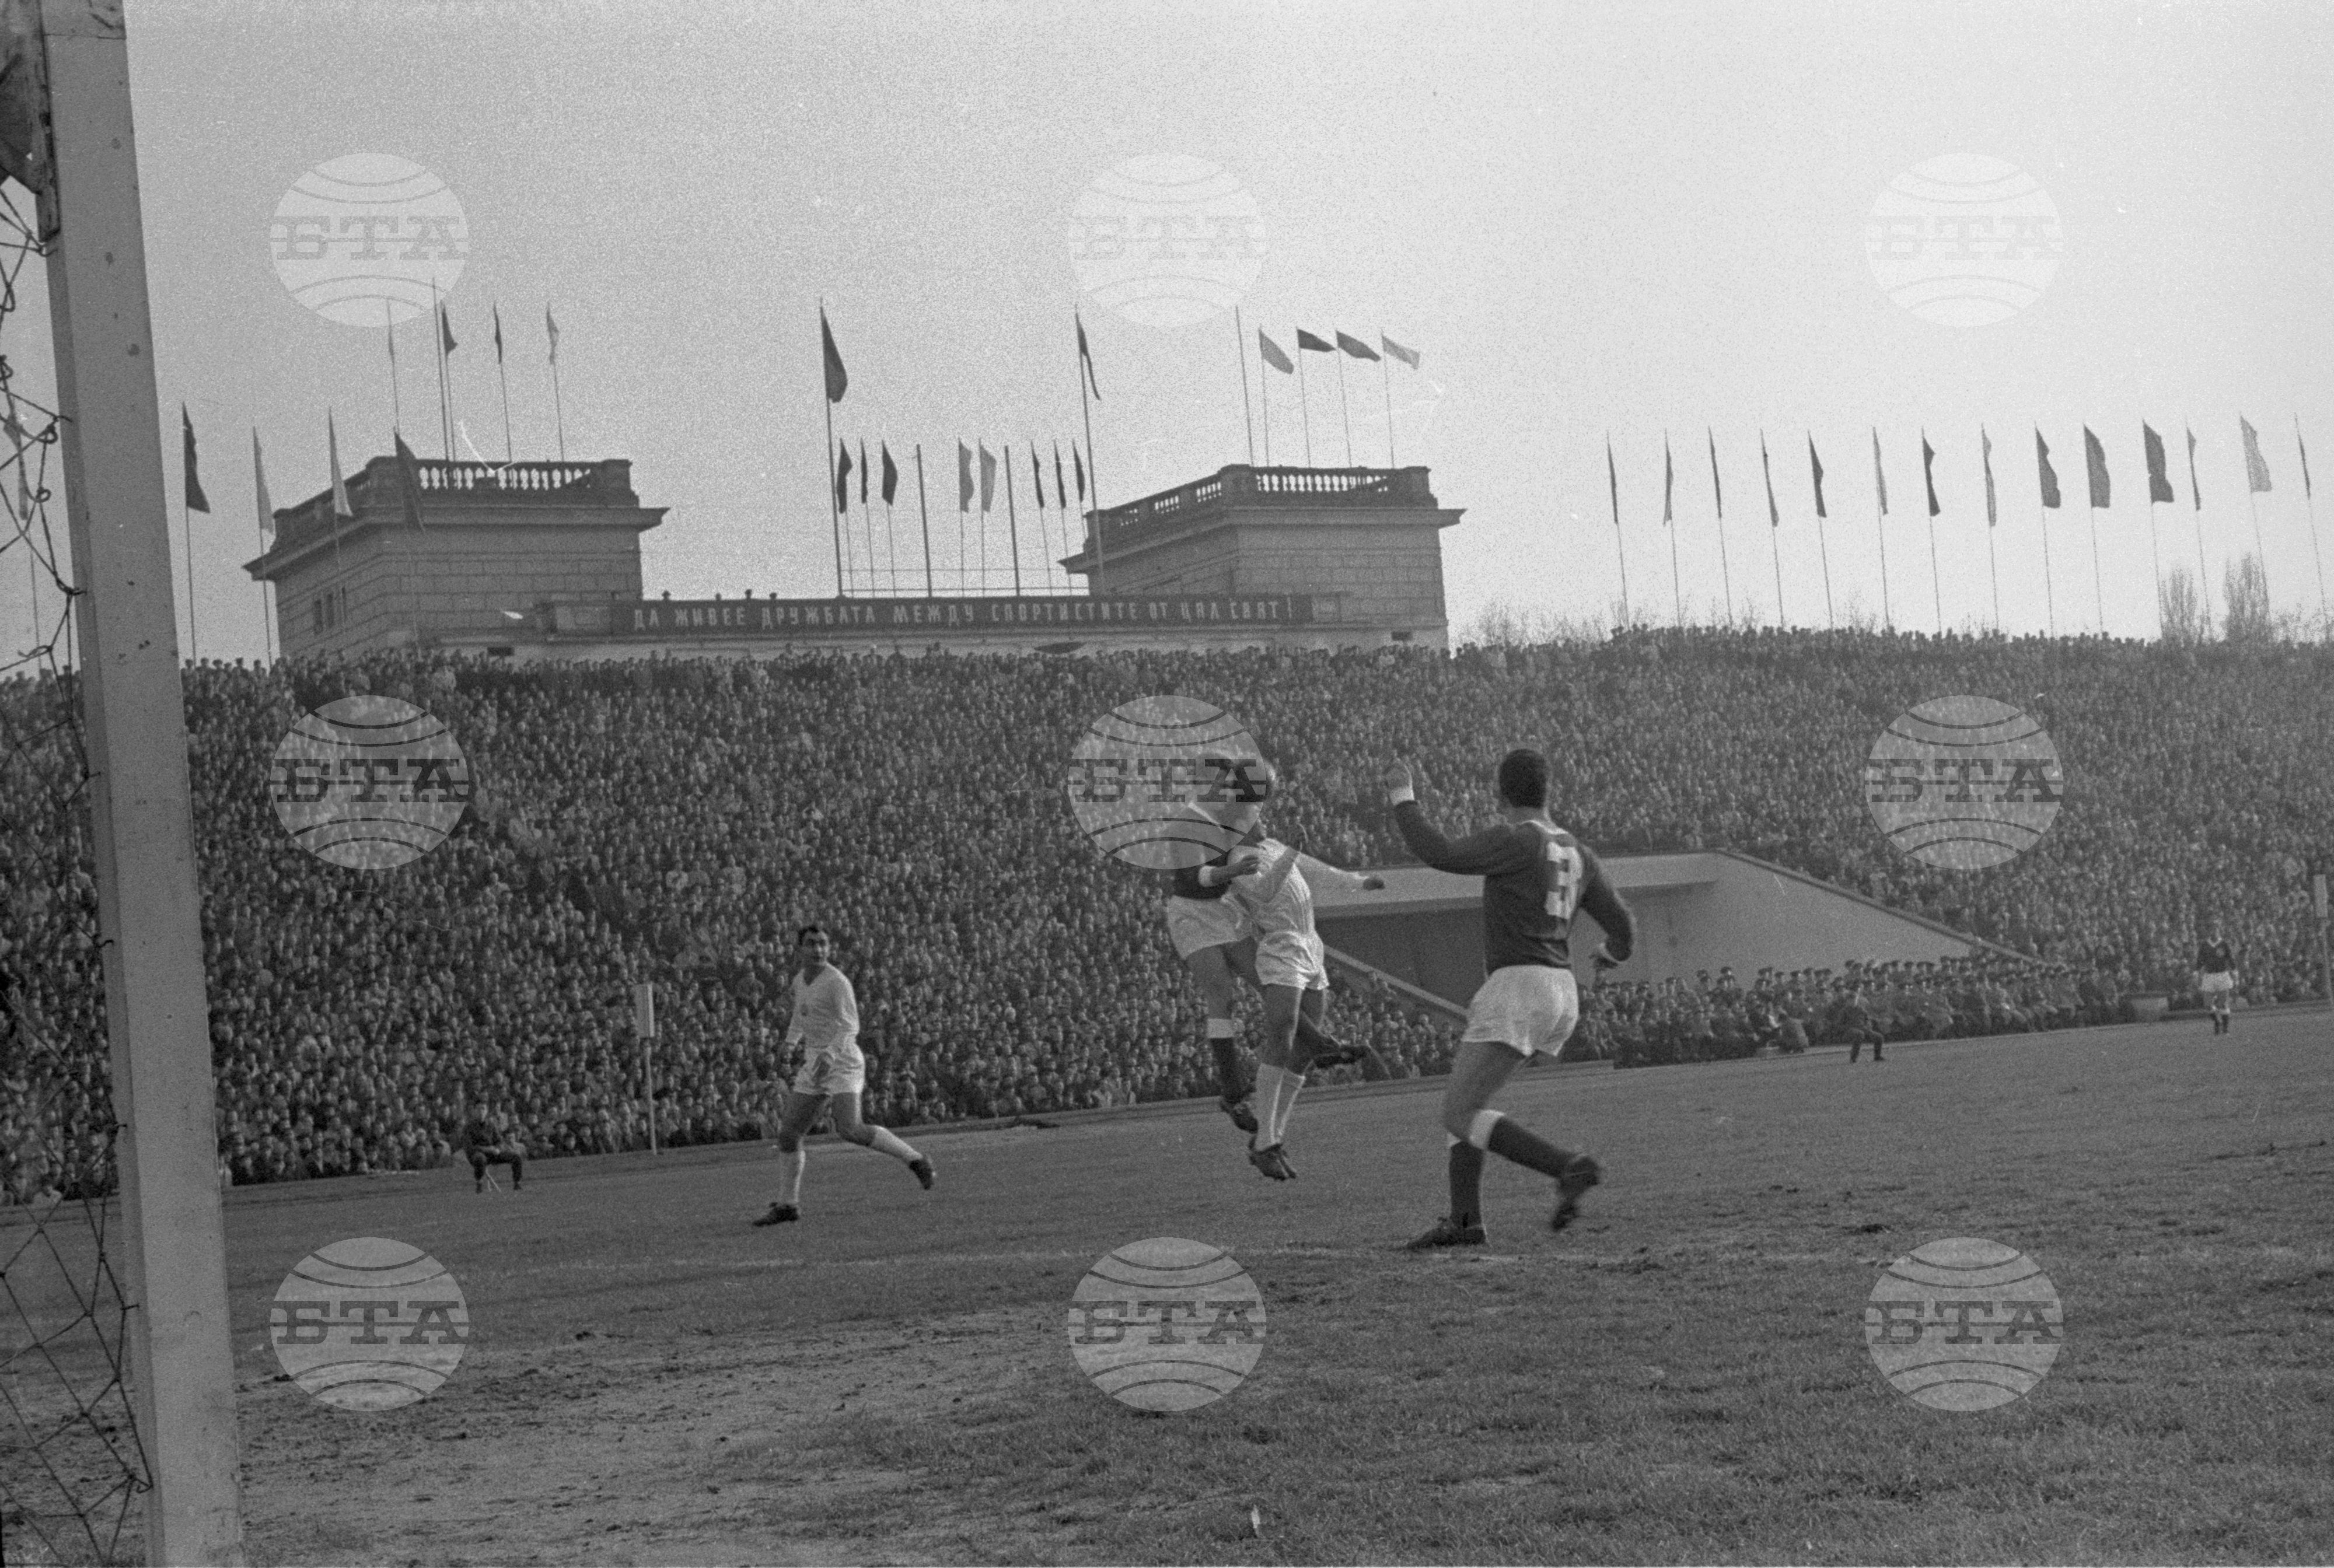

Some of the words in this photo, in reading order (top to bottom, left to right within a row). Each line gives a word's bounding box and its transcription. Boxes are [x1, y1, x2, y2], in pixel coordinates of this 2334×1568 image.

[634, 609, 659, 631] ДА
[761, 605, 875, 631] ДРУЖБАТА
[893, 603, 974, 626] МЕЖДУ
[991, 601, 1138, 621] СПОРТИСТИТЕ
[1149, 601, 1168, 620] ОТ
[1545, 841, 1583, 920] 3
